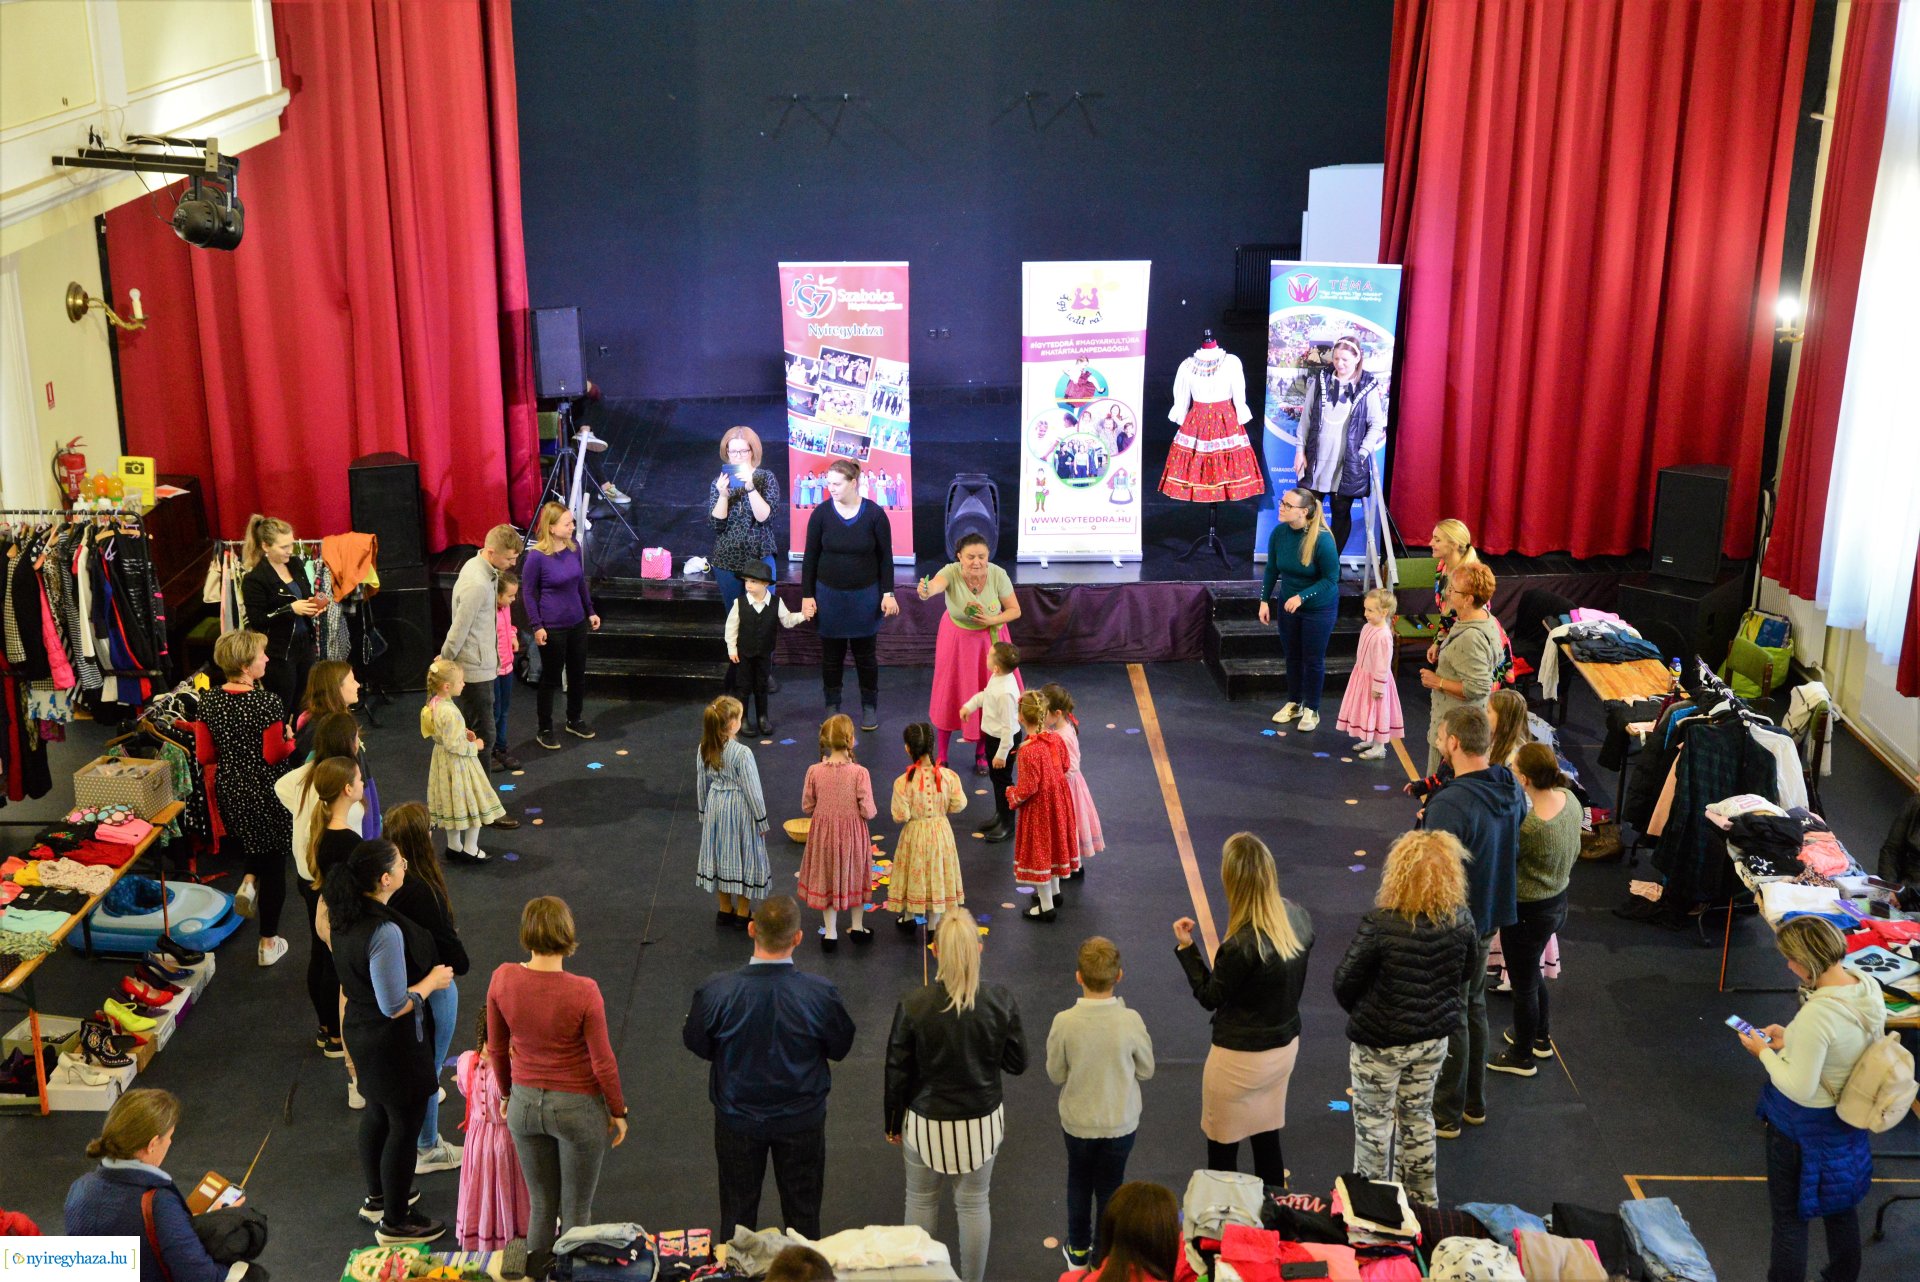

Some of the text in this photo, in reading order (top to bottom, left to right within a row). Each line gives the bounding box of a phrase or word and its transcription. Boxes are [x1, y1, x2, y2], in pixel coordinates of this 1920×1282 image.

[1328, 276, 1373, 291] TÉMA
[838, 288, 895, 303] Szabolcs
[807, 322, 884, 339] Nyíregyháza
[1040, 345, 1129, 356] #HATÁRTALANPEDAGÓGIA
[1031, 516, 1131, 524] WWW.IGYTEDDRA.HU
